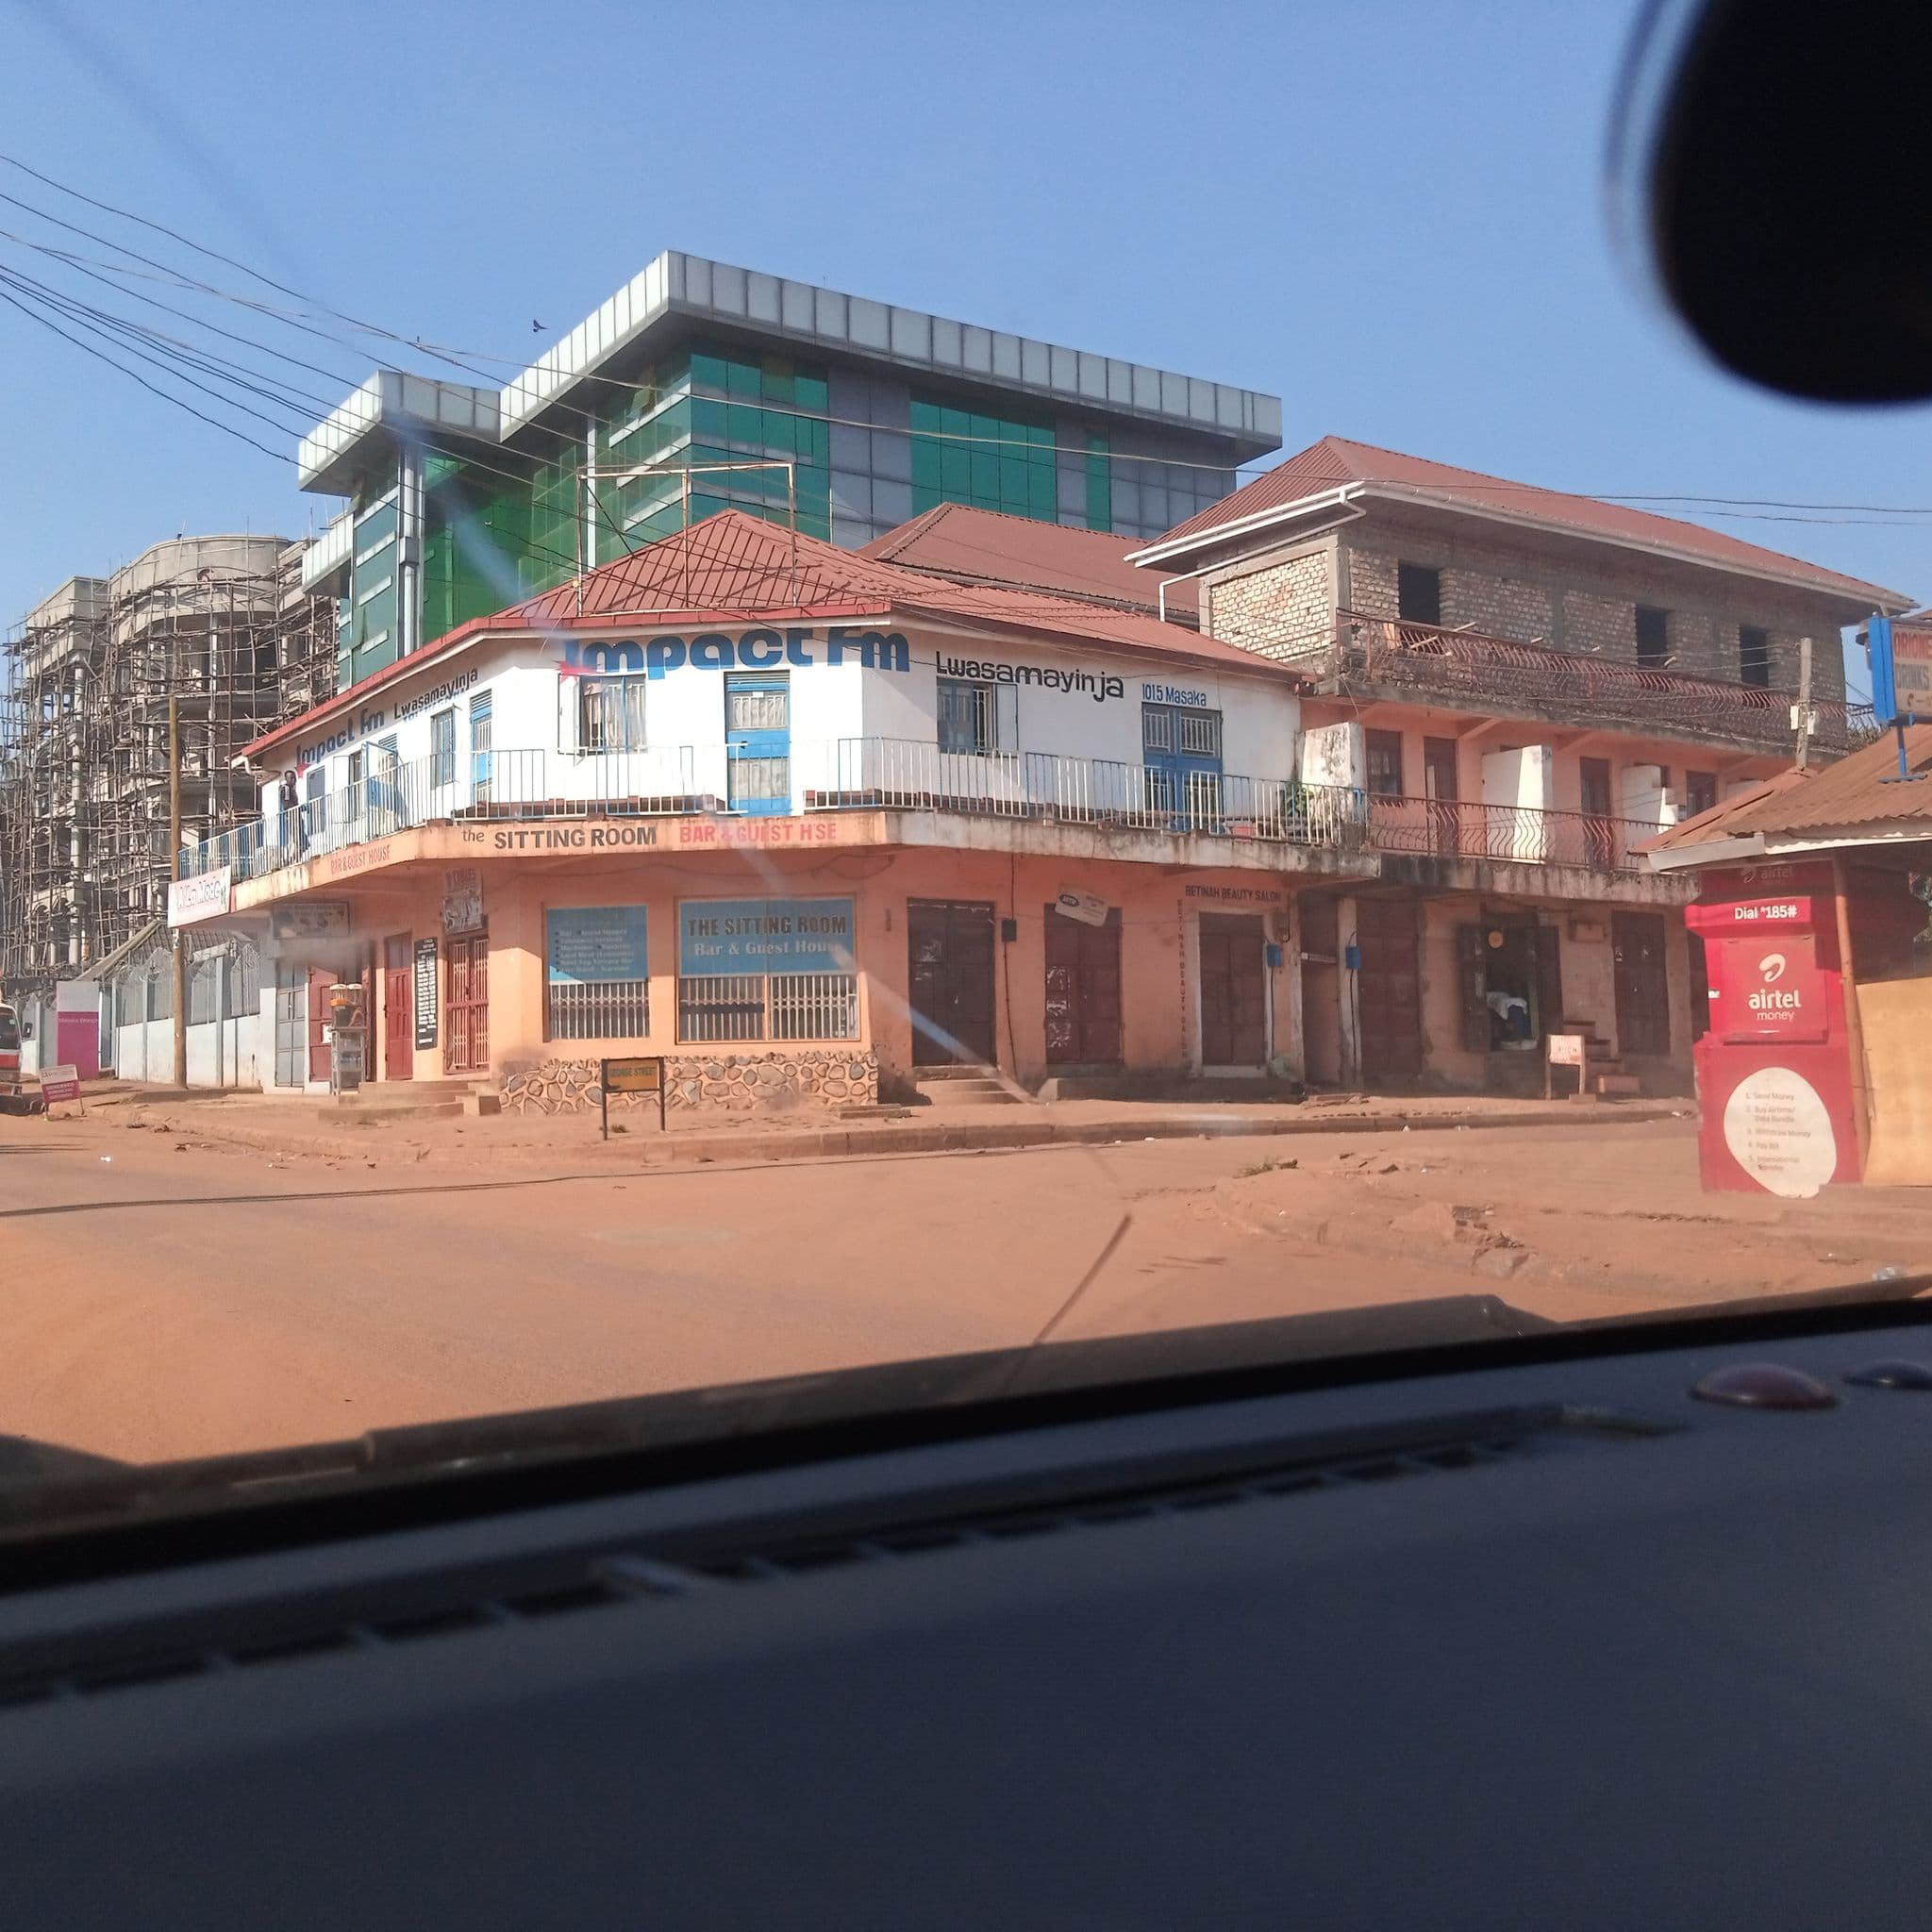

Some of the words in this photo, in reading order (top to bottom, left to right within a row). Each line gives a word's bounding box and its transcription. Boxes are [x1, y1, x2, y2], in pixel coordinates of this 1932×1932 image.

[563, 628, 813, 679] Impact
[936, 651, 1124, 702] Lwasamayinja
[393, 668, 478, 720] Lwasamayinja
[1165, 686, 1207, 707] Masaka
[296, 717, 356, 766] Impact
[462, 828, 485, 843] the
[494, 828, 586, 850] SITTING
[591, 826, 658, 847] ROOM
[679, 824, 715, 843] BAR
[736, 824, 793, 842] GUEST
[368, 844, 391, 866] HOUSE
[1759, 865, 1792, 878] airtel
[1222, 888, 1253, 900] BEAUTY
[1735, 906, 1758, 920] Dial
[688, 918, 719, 937] THE
[724, 916, 793, 936] SITTING
[797, 916, 846, 934] ROOM
[694, 942, 724, 957] Bar
[728, 942, 741, 956] &
[745, 941, 790, 955] Guest
[1748, 989, 1802, 1009] airtel
[1757, 1010, 1795, 1022] money
[1773, 1092, 1795, 1101] Money
[1755, 1106, 1767, 1115] Buy
[1788, 1130, 1812, 1140] Money
